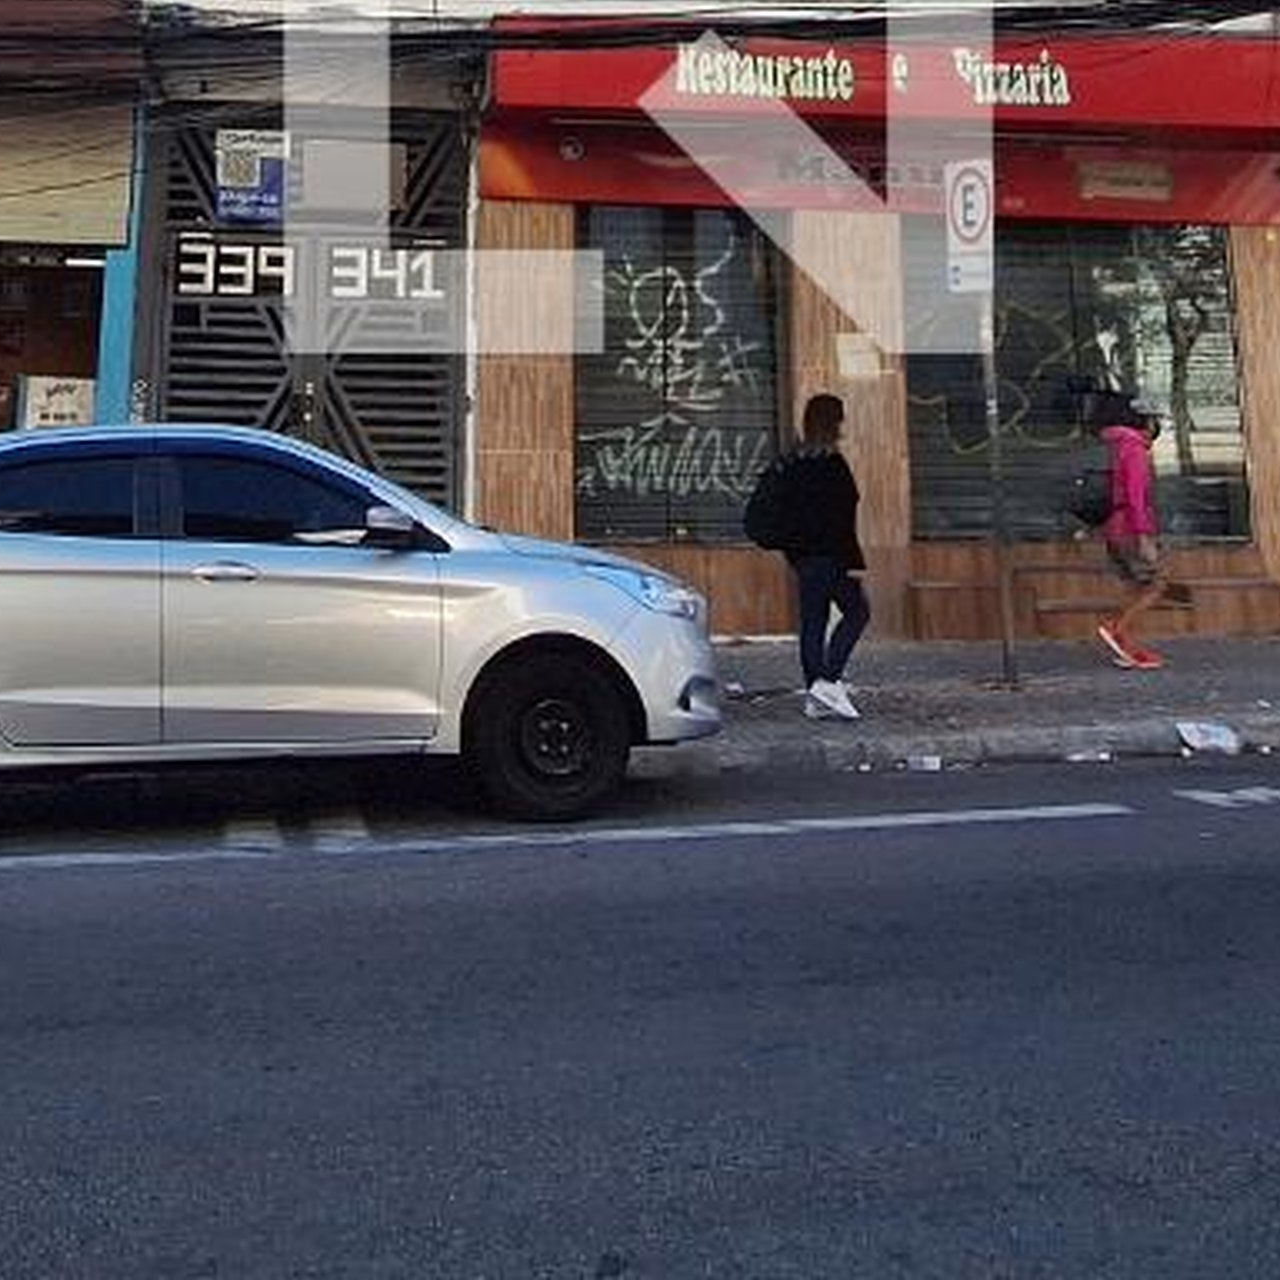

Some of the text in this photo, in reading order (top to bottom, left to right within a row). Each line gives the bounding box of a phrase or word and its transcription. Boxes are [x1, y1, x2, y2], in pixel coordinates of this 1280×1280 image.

[676, 41, 854, 102] Restaurante
[891, 51, 908, 93] e
[961, 183, 977, 227] E
[177, 242, 446, 299] 339 341
